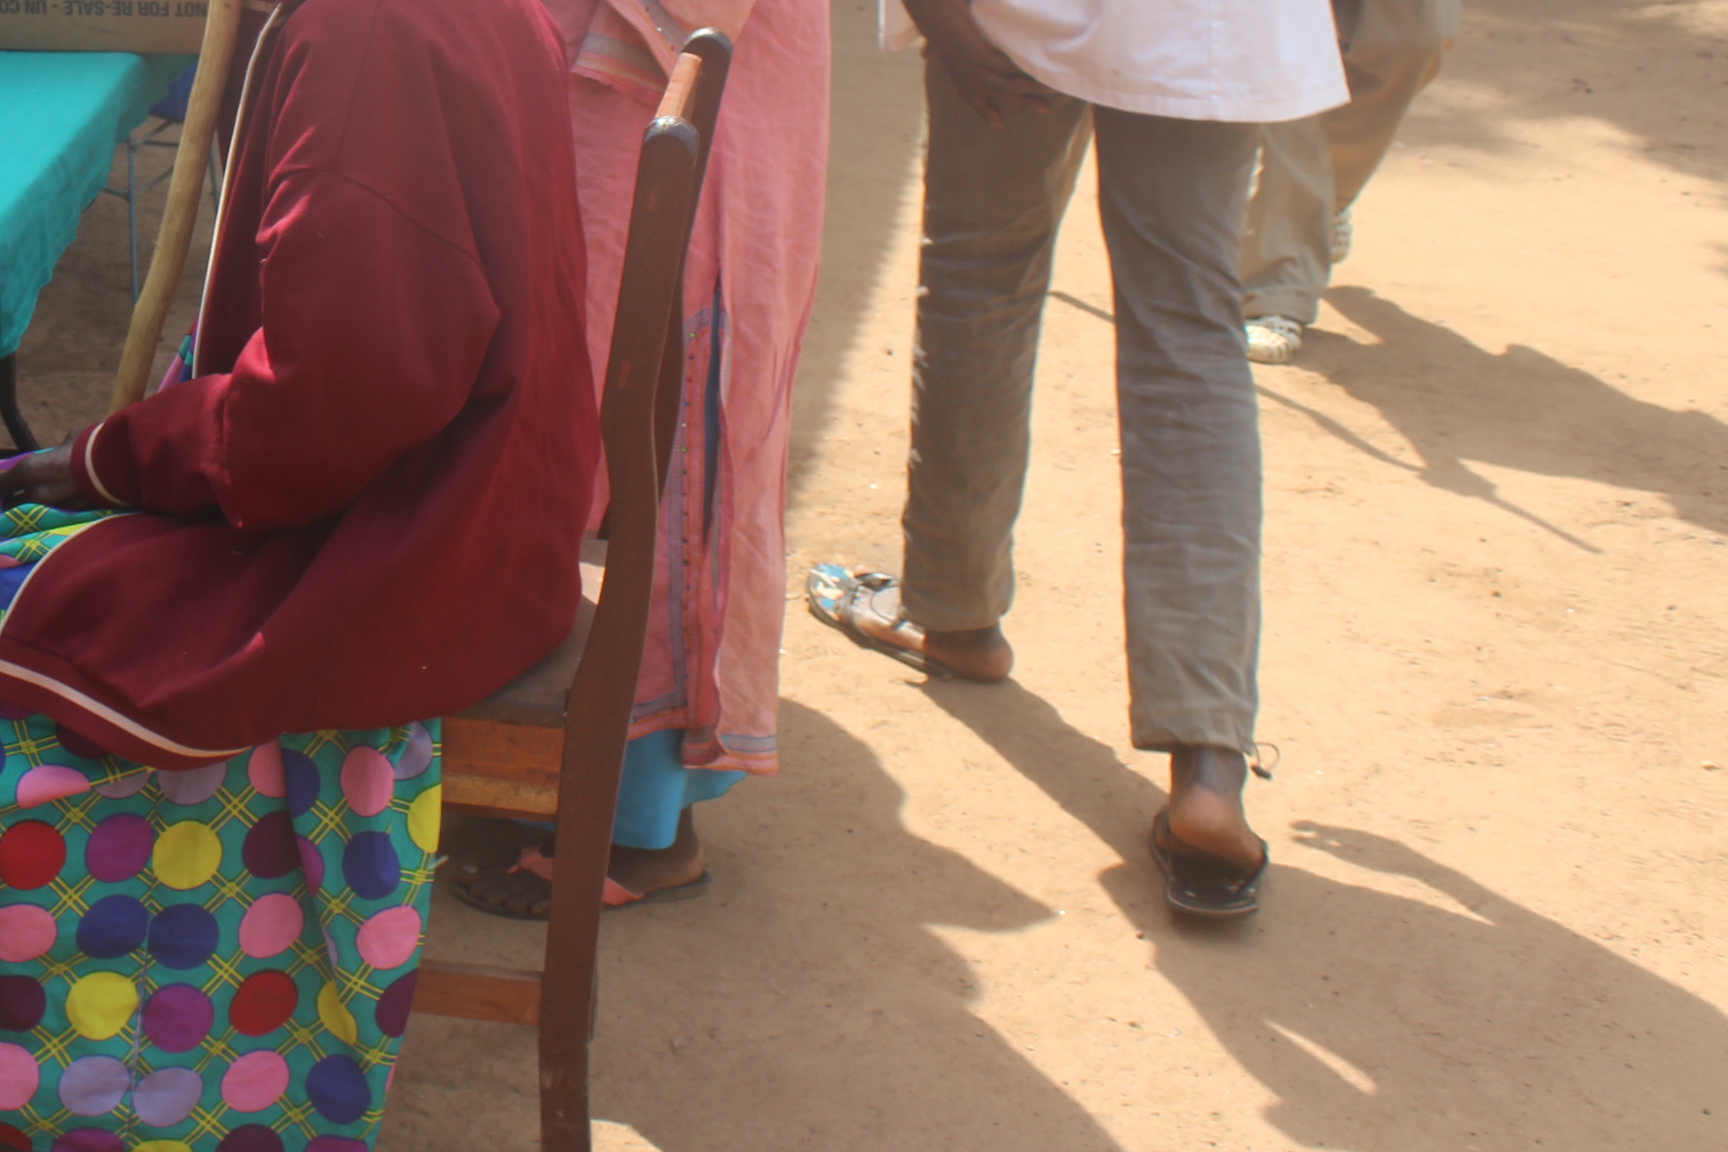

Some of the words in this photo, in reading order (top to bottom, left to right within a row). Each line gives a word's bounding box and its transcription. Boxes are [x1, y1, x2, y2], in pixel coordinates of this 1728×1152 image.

[24, 0, 47, 15] UN
[64, 0, 133, 16] RE-SALE
[138, 1, 170, 17] FOR
[174, 2, 208, 17] NOT
